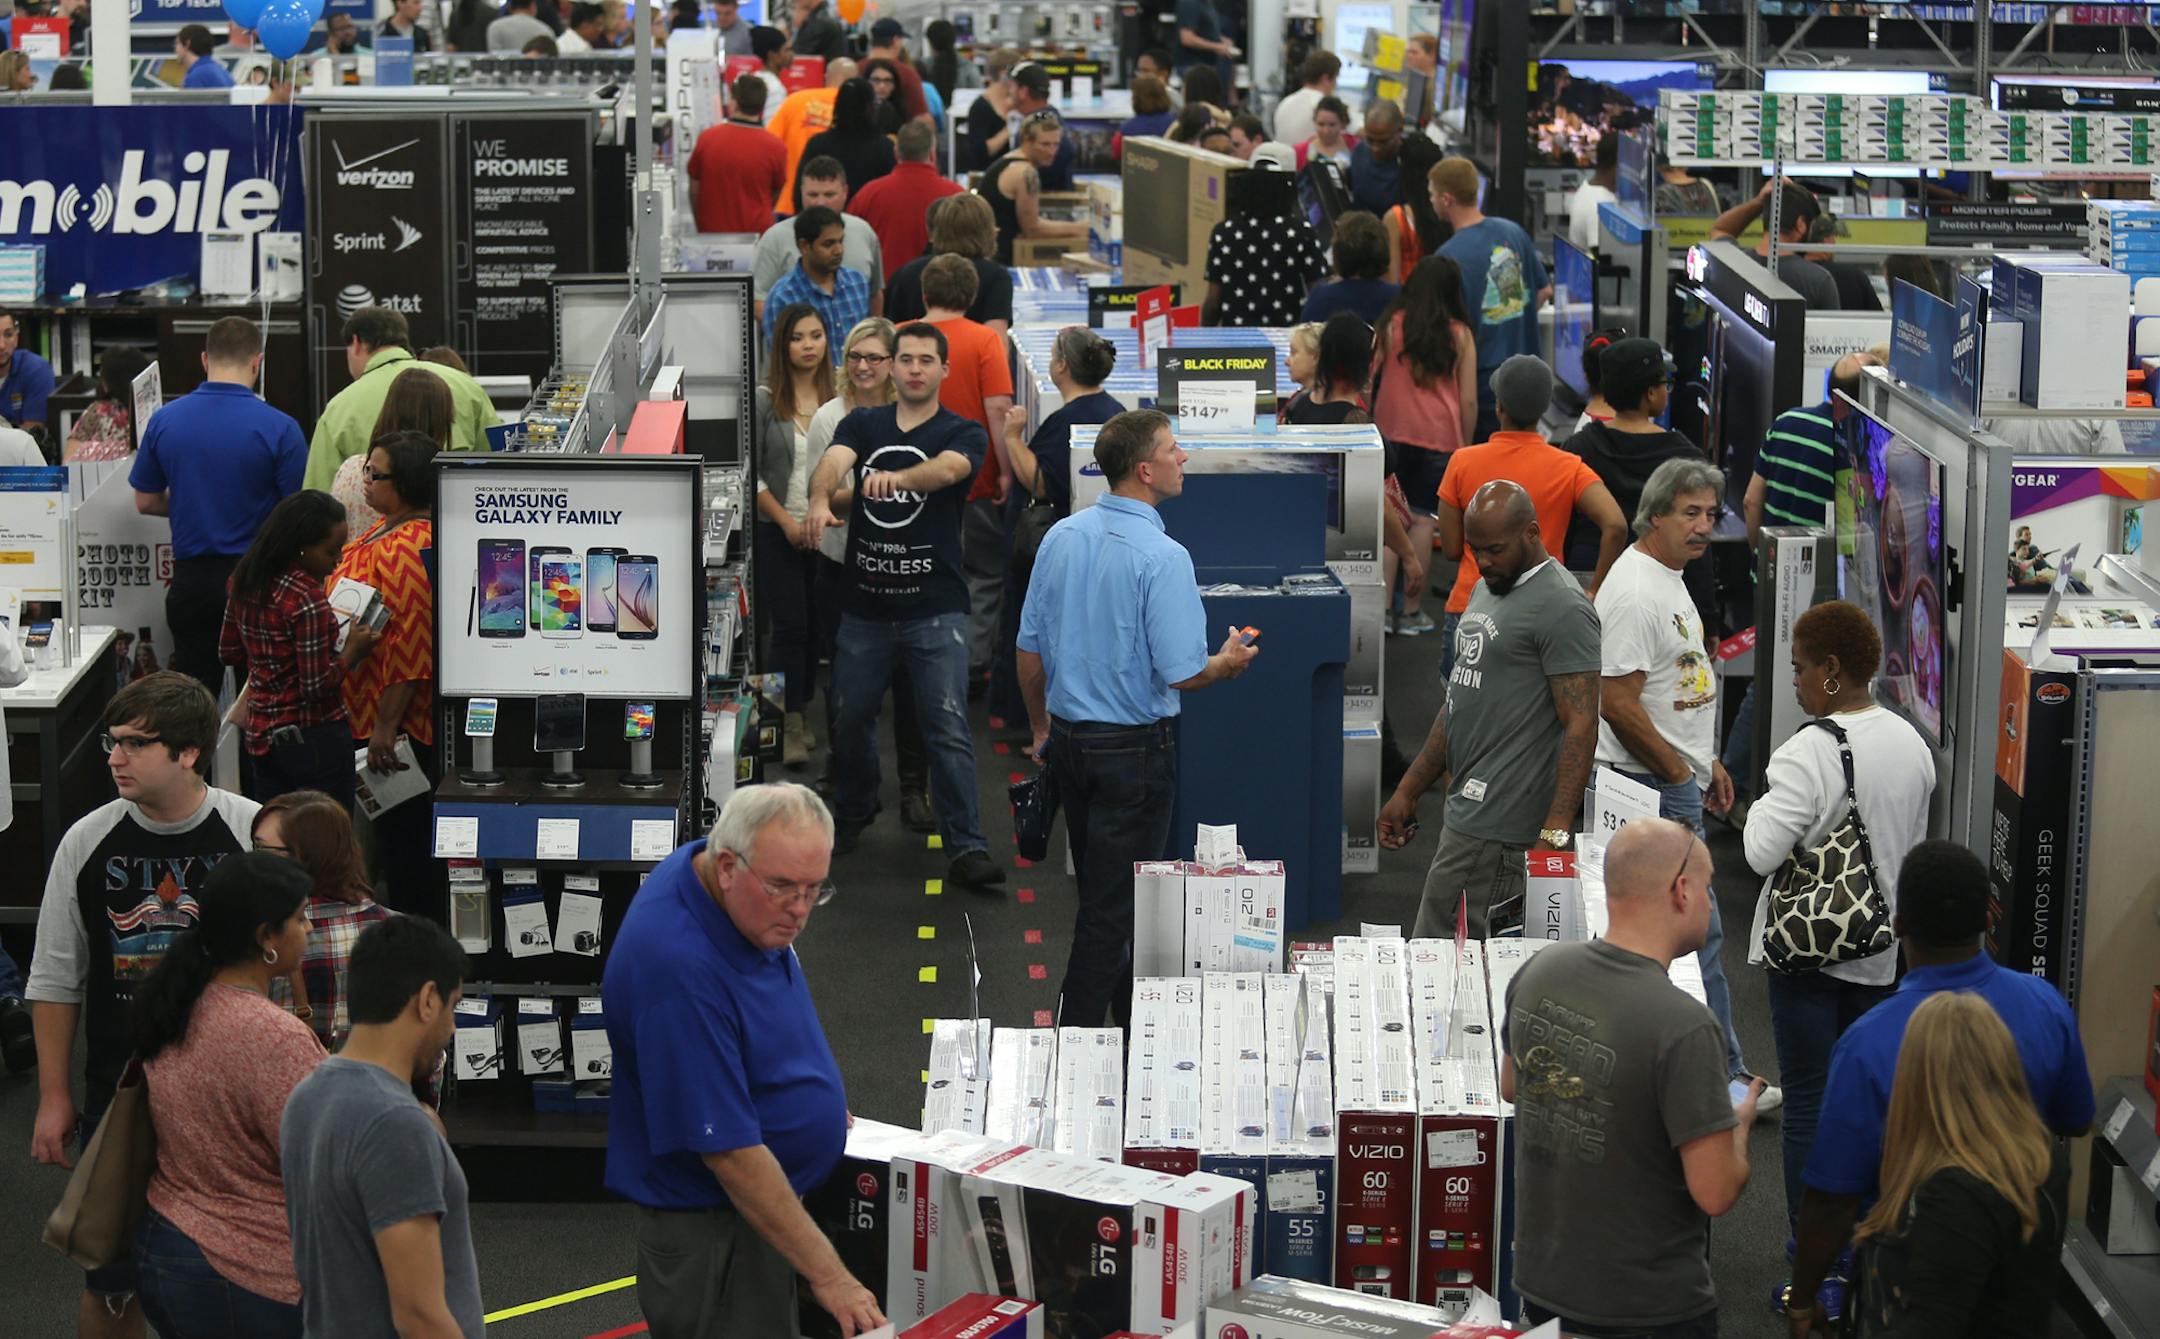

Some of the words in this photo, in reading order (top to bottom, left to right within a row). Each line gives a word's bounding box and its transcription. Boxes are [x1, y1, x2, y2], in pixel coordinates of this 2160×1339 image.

[474, 140, 506, 157] WE
[475, 159, 568, 176] PROMISE
[337, 168, 414, 186] verizon
[474, 187, 490, 195] THE
[492, 187, 520, 195] LATEST
[521, 187, 555, 195] DEVICES
[556, 187, 575, 195] AND
[474, 203, 499, 211] PLACE
[1952, 206, 2009, 215] MONSTER
[2010, 207, 2052, 216] POWER
[519, 228, 549, 236] ADVICE
[1940, 220, 1978, 231] Protects
[1980, 220, 2012, 232] Family,
[2015, 221, 2042, 231] Home
[2044, 221, 2062, 231] and
[333, 232, 386, 253] Sprint
[475, 246, 528, 254] COMPETITIVE
[706, 260, 734, 270] SPORT
[381, 294, 422, 313] at&t
[1809, 345, 1847, 354] SMART
[1852, 346, 1867, 354] TV
[1953, 334, 1974, 359] HOLIDAYS
[1184, 359, 1223, 370] BLACK
[1226, 358, 1267, 370] FRIDAY
[475, 494, 568, 508] SAMSUNG
[475, 510, 552, 524] GALAXY
[557, 510, 623, 525] FAMILY
[882, 542, 907, 553] 1986
[491, 552, 512, 562] 12:45
[1783, 565, 1791, 592] AUDIO
[1781, 614, 1789, 643] SMART
[2037, 830, 2053, 876] GEEK
[2032, 884, 2050, 949] SQUAD
[1539, 998, 1596, 1030] DON'T
[1513, 1007, 1616, 1087] TREAD
[1349, 1145, 1404, 1159] VIZIO
[857, 1200, 874, 1230] LG
[916, 1197, 926, 1239] LAS454B
[929, 1202, 939, 1237] 300W
[1099, 1246, 1117, 1276] LG
[1166, 1243, 1175, 1285] LAS454B
[1178, 1248, 1188, 1284] 300W
[912, 1278, 926, 1317] sound
